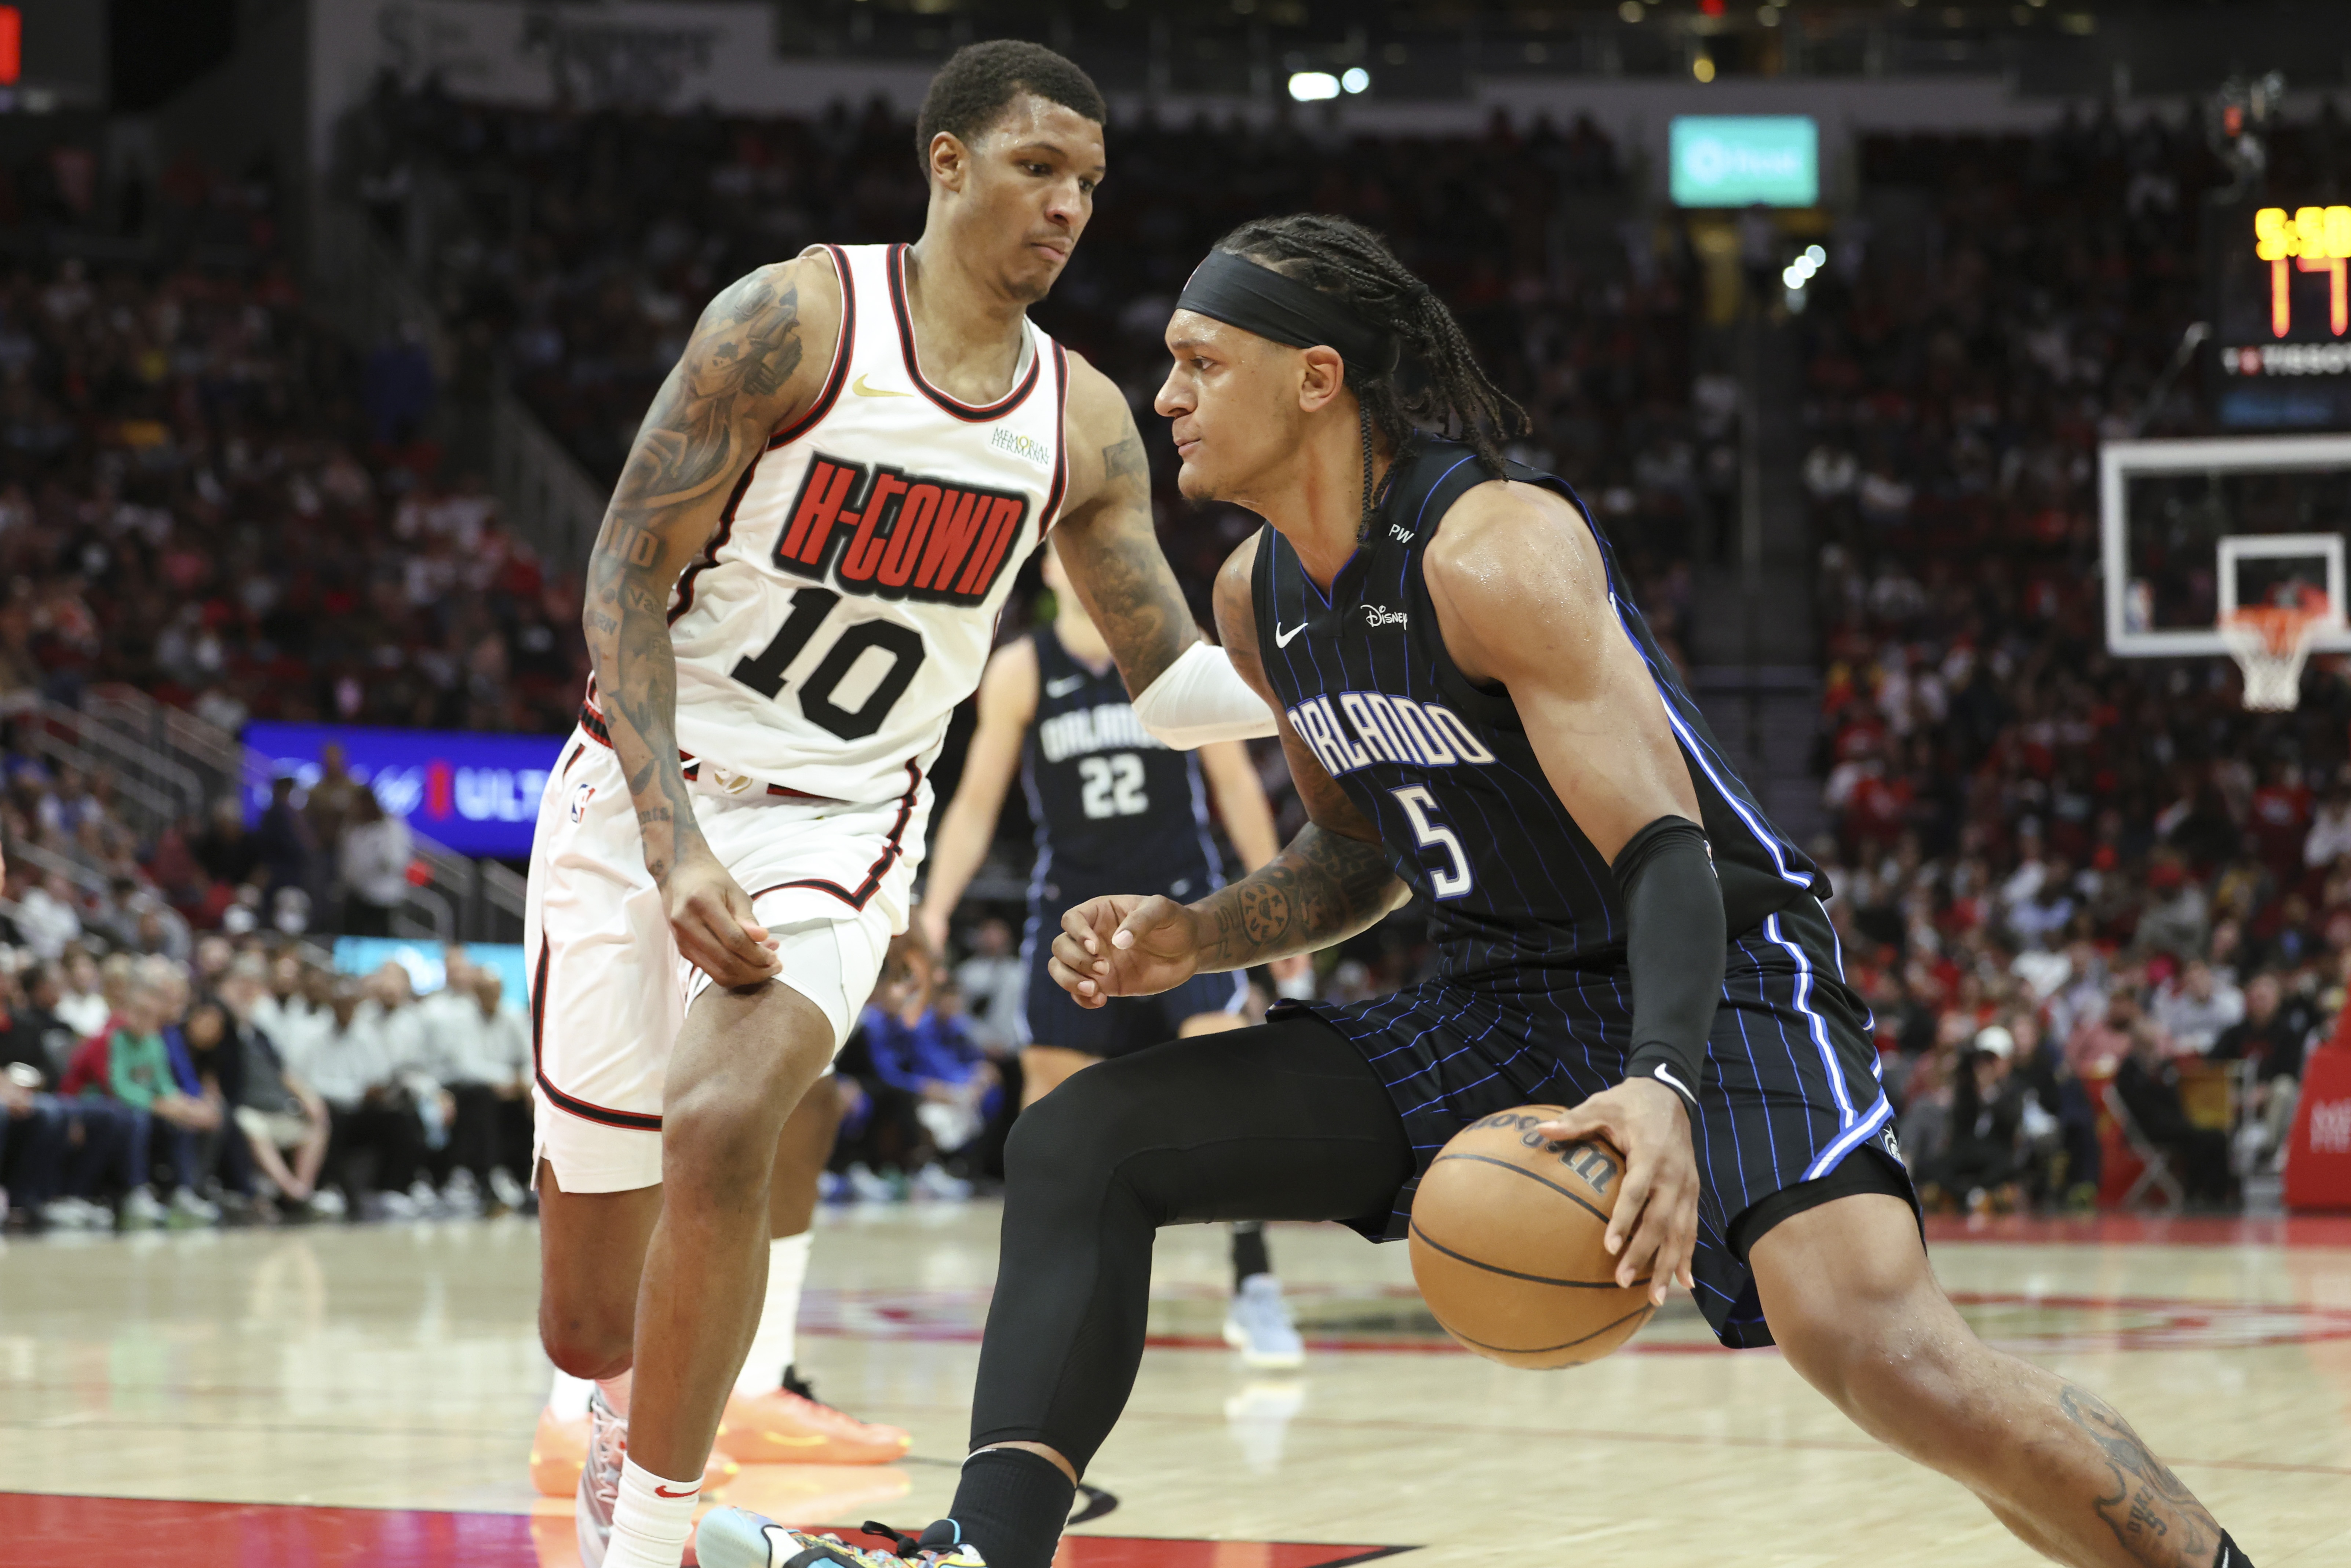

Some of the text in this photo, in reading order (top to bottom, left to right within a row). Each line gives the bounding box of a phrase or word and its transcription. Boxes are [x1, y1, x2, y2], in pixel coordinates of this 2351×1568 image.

[991, 435, 1050, 465] HERMANN
[993, 426, 1050, 458] MEMORIAL
[778, 458, 1024, 597] H-TOWN
[1388, 524, 1415, 544] PW
[731, 587, 927, 744] 10
[1040, 702, 1172, 763] ORLAN
[1286, 690, 1499, 779] ORLANDO
[1078, 752, 1149, 820] 22
[1386, 783, 1474, 902] 5
[2126, 1484, 2154, 1534] DUKE
